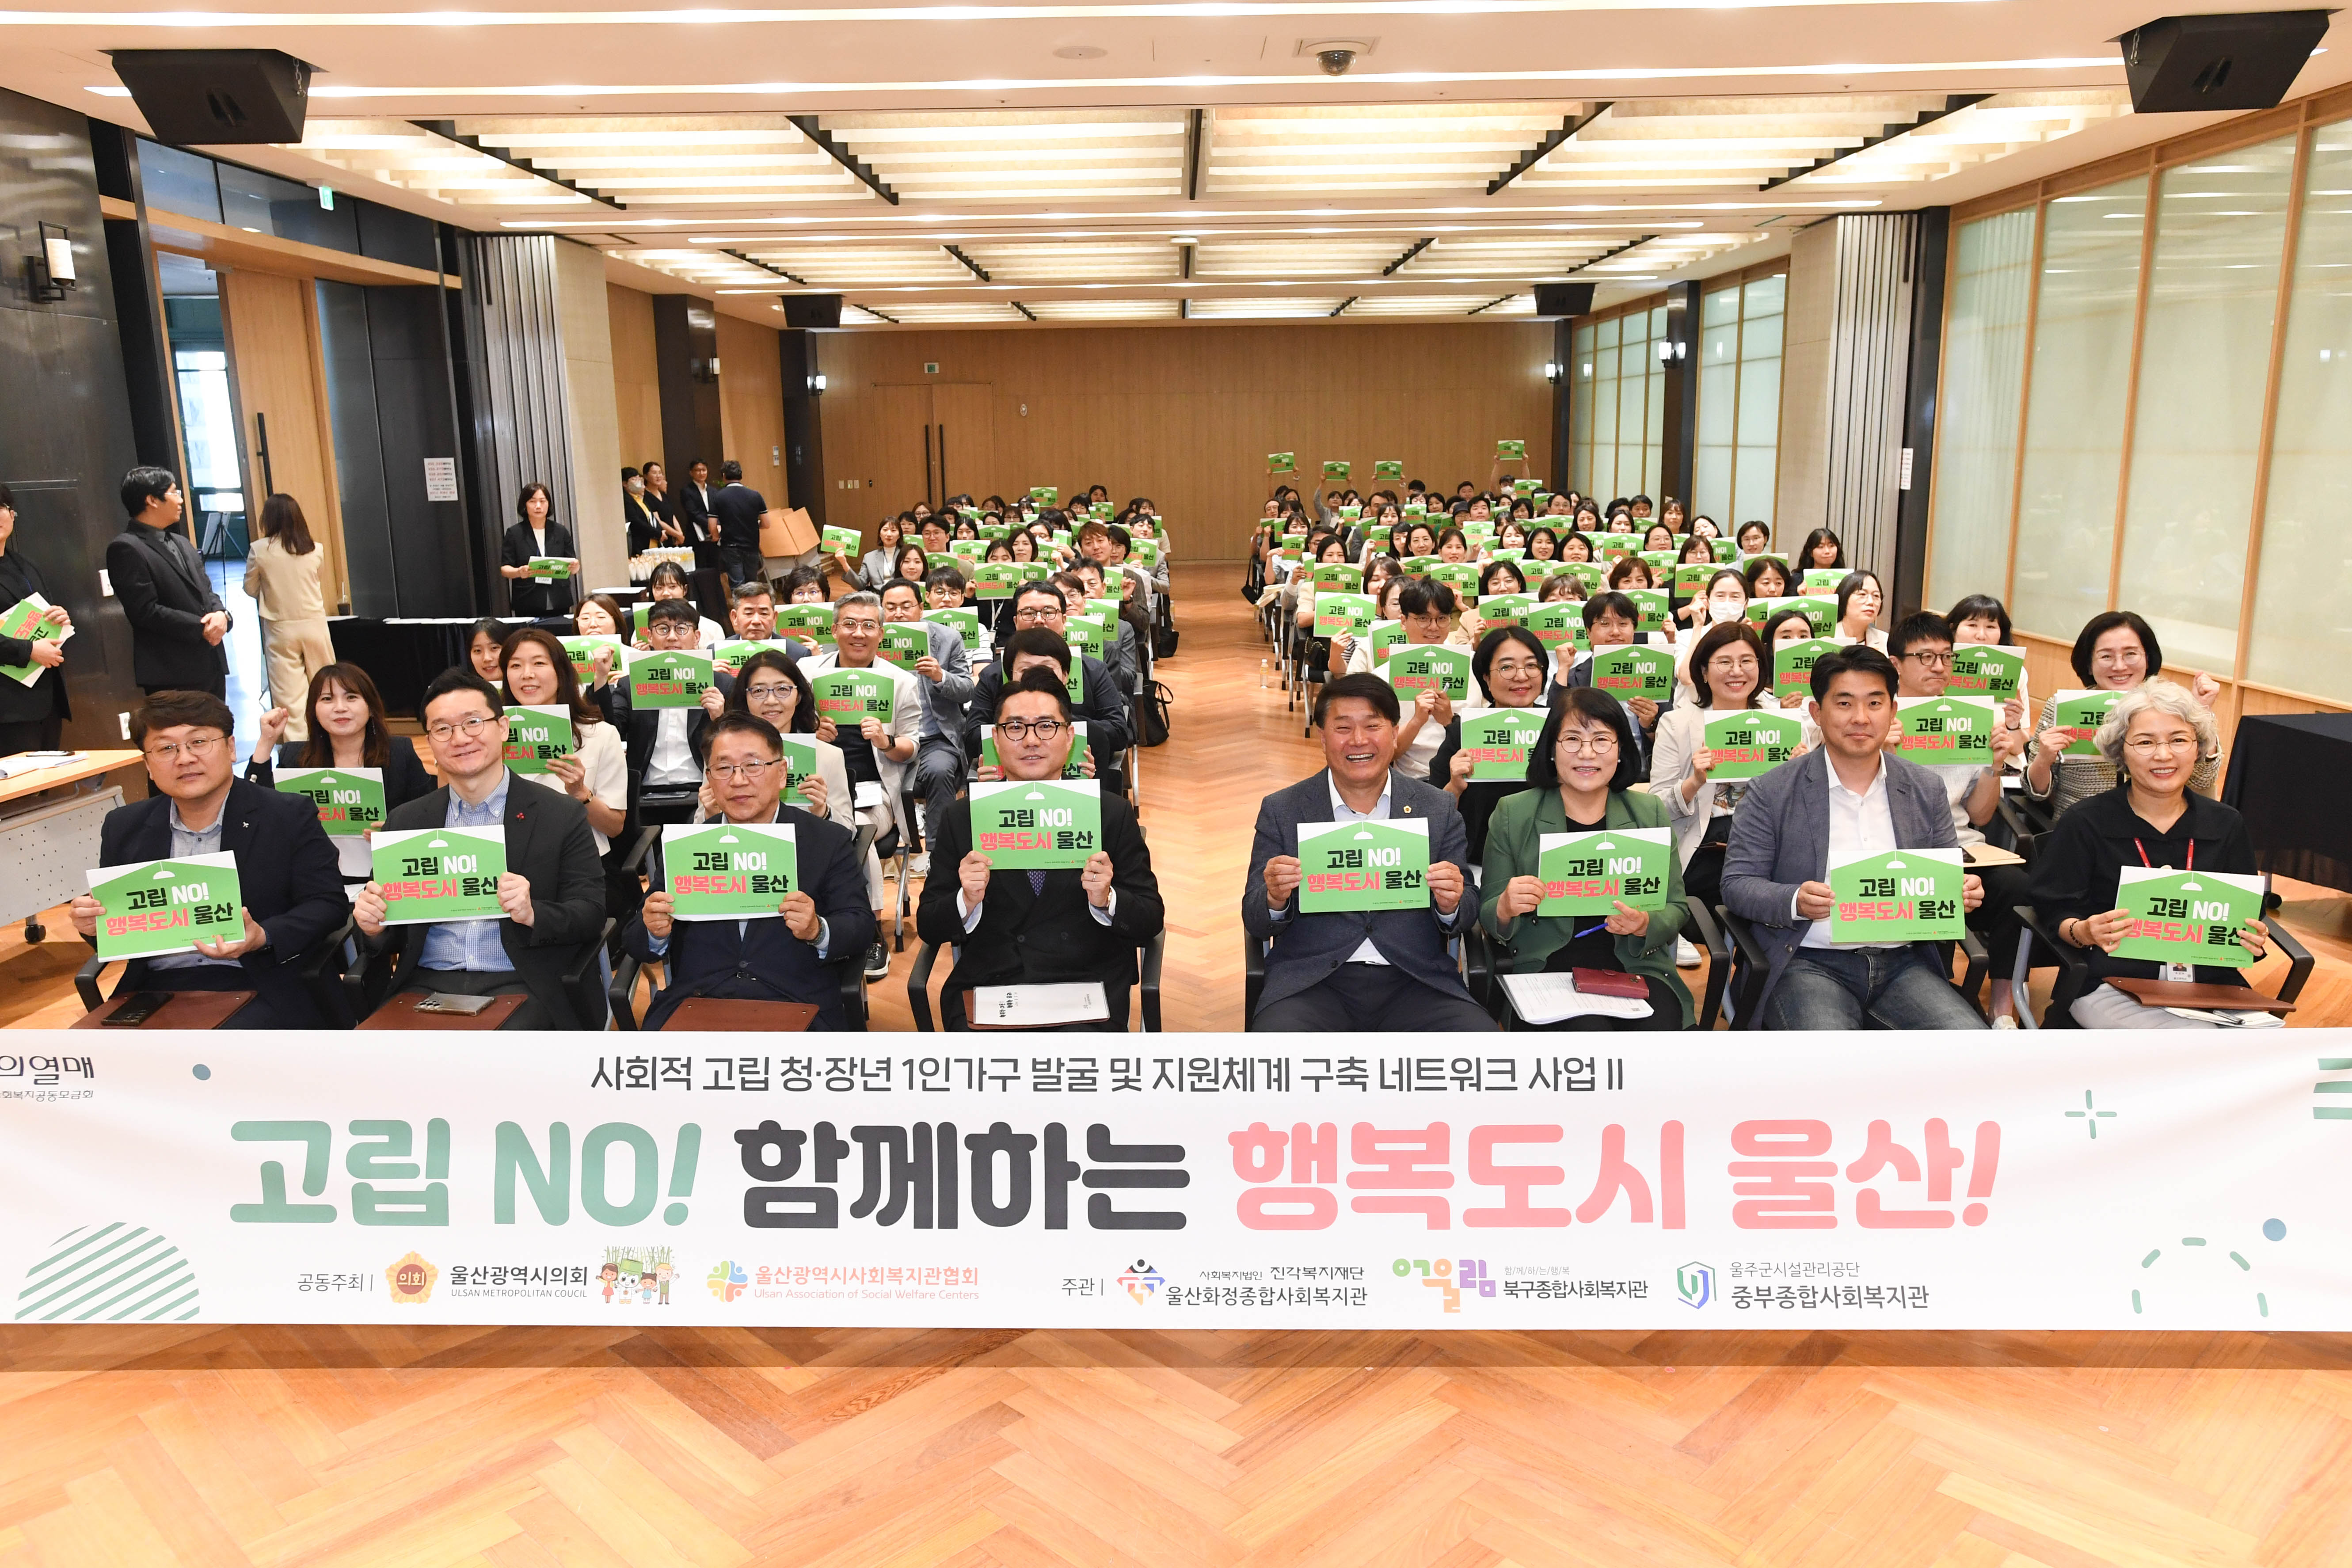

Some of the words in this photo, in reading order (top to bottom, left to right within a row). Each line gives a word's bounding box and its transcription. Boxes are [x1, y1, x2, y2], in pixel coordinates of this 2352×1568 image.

[1339, 573, 1351, 582] NO!
[1328, 605, 1346, 616] 고립
[1347, 607, 1363, 616] NO!
[1492, 608, 1510, 617] 고립
[1511, 606, 1528, 617] NO!
[1640, 602, 1656, 612] NO!
[788, 617, 804, 627] 고립
[807, 616, 823, 626] NO!
[1319, 616, 1353, 627] 행복도시
[1544, 617, 1564, 628] 고립
[1647, 613, 1665, 622] 울산
[1813, 622, 1832, 632] 울산
[1070, 631, 1088, 641] NO!
[1387, 634, 1407, 644] 고립
[1533, 629, 1573, 641] 행복도시
[894, 638, 913, 648] NO!
[1080, 643, 1099, 653] 울산
[647, 668, 671, 681] 고립
[674, 667, 695, 680] NO!
[1406, 662, 1429, 674] 고립
[1432, 662, 1453, 674] NO!
[1610, 662, 1633, 674] 고립
[1636, 662, 1656, 674] NO!
[1953, 662, 1978, 674] 고립
[1980, 663, 2004, 676] NO!
[636, 682, 683, 696] 행복도시
[685, 681, 709, 694] 울산
[1393, 676, 1439, 689] 행복도시
[1596, 676, 1642, 689] 행복도시
[1644, 676, 1667, 689] 울산
[1989, 677, 2014, 691] 울산
[830, 685, 853, 697] 고립
[855, 684, 876, 696] NO!
[818, 699, 864, 712] 행복도시
[866, 699, 889, 712] 울산
[1915, 718, 1943, 732] 고립
[1946, 717, 1972, 732] NO!
[522, 727, 549, 742] NO!
[1483, 730, 1511, 745] 고립
[1725, 731, 1752, 745] 고립
[1755, 730, 1781, 745] NO!
[1901, 735, 1955, 750] 행복도시
[1958, 735, 1987, 749] 울산
[333, 789, 361, 804] NO!
[349, 807, 379, 822] 울산
[998, 809, 1034, 828] 고립
[1039, 808, 1072, 827] NO!
[979, 832, 1052, 851] 행복도시
[1057, 831, 1093, 850] 울산
[693, 852, 728, 871] 고립
[733, 852, 767, 871] NO!
[1327, 849, 1362, 868] 고립
[1368, 847, 1401, 867] NO!
[402, 856, 439, 877] 고립
[444, 855, 477, 875] NO!
[1567, 858, 1603, 877] 고립
[1608, 856, 1642, 875] NO!
[383, 879, 457, 901] 행복도시
[462, 876, 498, 897] 울산
[674, 875, 747, 895] 행복도시
[752, 874, 789, 894] 울산
[1307, 871, 1380, 893] 행복도시
[1385, 869, 1422, 889] 울산
[1545, 879, 1619, 898] 행복도시
[1624, 876, 1661, 895] 울산
[1858, 878, 1895, 898] 고립
[1900, 877, 1935, 896] NO!
[126, 888, 167, 910] 고립
[172, 883, 209, 904] NO!
[1838, 901, 1914, 921] 행복도시
[1918, 900, 1956, 920] 울산
[2147, 897, 2188, 918] 고립
[2192, 900, 2230, 921] NO!
[106, 909, 190, 936] 행복도시
[194, 902, 234, 925] 울산
[590, 1056, 692, 1092] 사회적
[702, 1057, 770, 1092] 고립
[780, 1056, 892, 1092] 청·장년
[902, 1057, 1021, 1093] 1인가구
[1031, 1057, 1100, 1093] 발굴
[1110, 1057, 1142, 1092] 및
[1152, 1057, 1290, 1093] 지원체계
[1301, 1056, 1370, 1093] 구축
[1379, 1057, 1519, 1092] 네트워크
[1528, 1057, 1596, 1092] 사업
[0, 1090, 94, 1102] 회복지공동모금회
[230, 1118, 451, 1227] 고립
[494, 1121, 702, 1227] NO!
[734, 1119, 1191, 1231] 함께하는
[1228, 1120, 1686, 1231] 행복도시
[1728, 1118, 2002, 1230] 울산!
[450, 1266, 588, 1286] 울산광역시의회
[755, 1266, 978, 1286] 울산광역시사회복지관협회
[1199, 1271, 1263, 1281] 사회복지법인
[1270, 1267, 1365, 1280] 진각복지재단
[1504, 1266, 1570, 1276] 함/께/하/는/행/복
[1728, 1261, 1860, 1278] 울주군시설관리공단
[297, 1273, 364, 1293] 공동주최
[398, 1271, 426, 1286] 의회
[451, 1289, 480, 1298] ULSAN
[483, 1289, 552, 1298] METROPOLITAN
[555, 1289, 588, 1298] COUCIL
[754, 1289, 783, 1299] Ulsan
[786, 1289, 845, 1299] Association
[848, 1289, 858, 1299] of
[862, 1289, 892, 1299] Social
[895, 1290, 936, 1300] Welfare
[939, 1290, 979, 1300] Centers
[1061, 1278, 1096, 1298] 주관
[1503, 1280, 1648, 1298] 북구종합사회복지관
[1165, 1287, 1368, 1306] 울산화정종합사회복지관
[1730, 1286, 1930, 1310] 중부종합사회복지관
